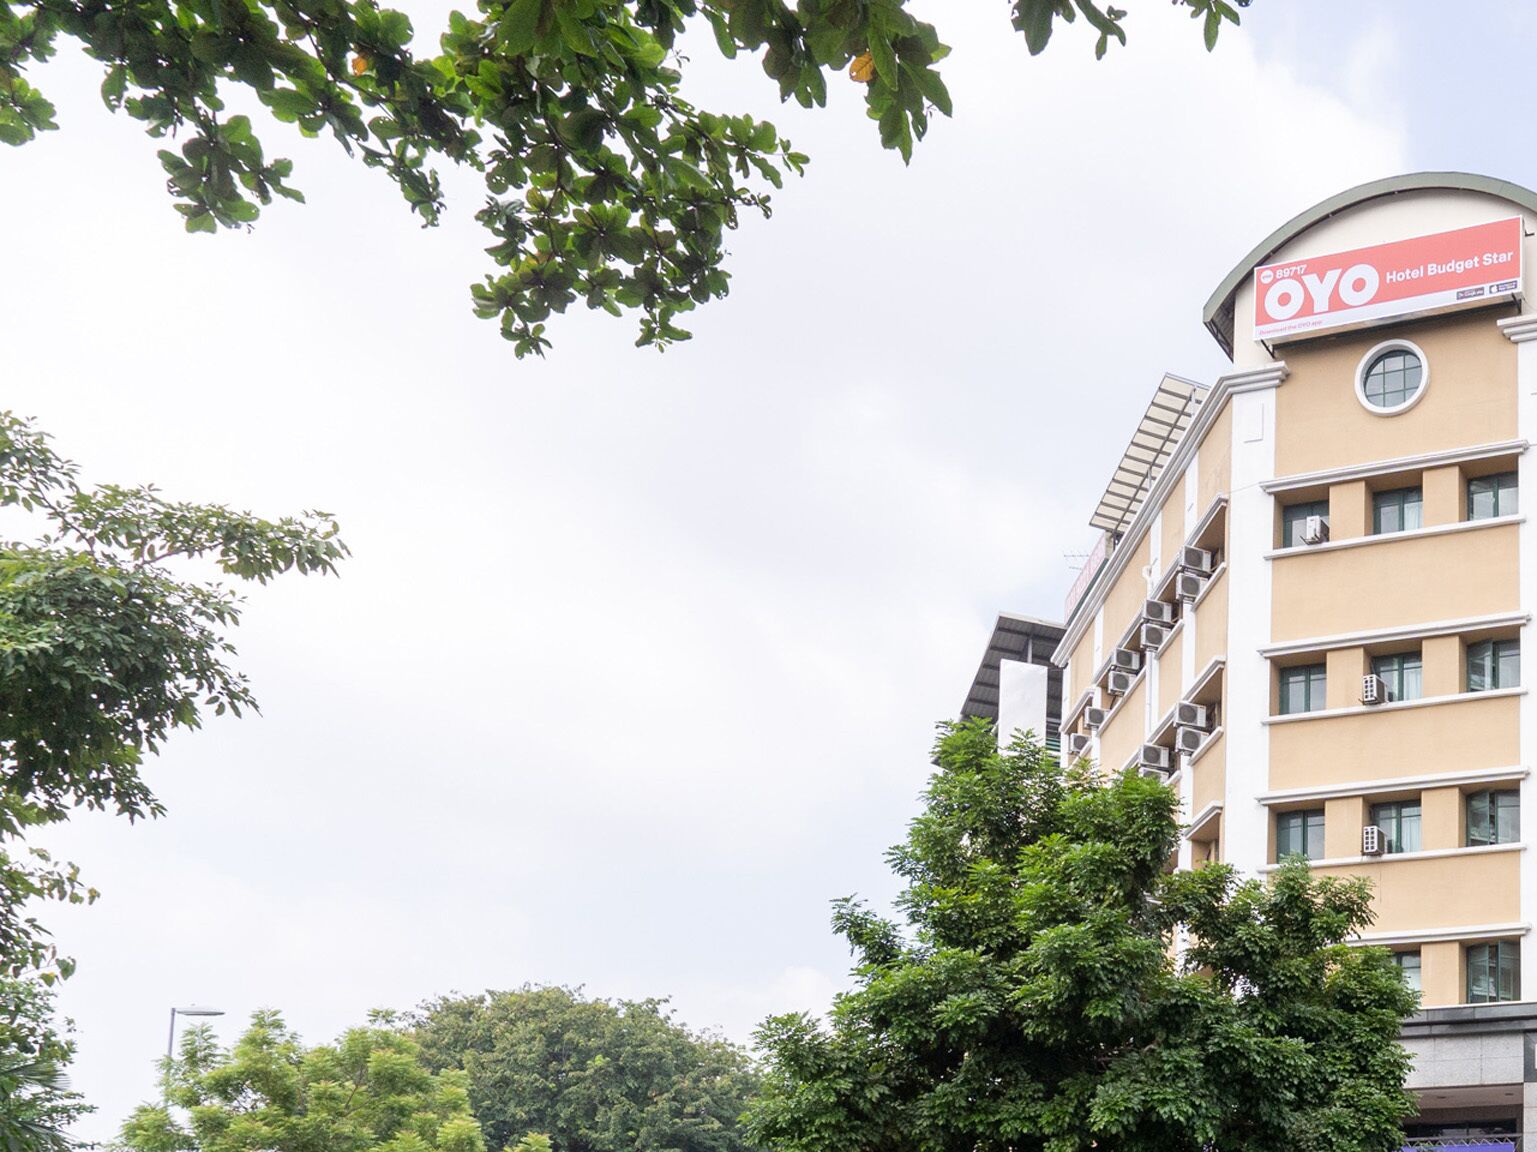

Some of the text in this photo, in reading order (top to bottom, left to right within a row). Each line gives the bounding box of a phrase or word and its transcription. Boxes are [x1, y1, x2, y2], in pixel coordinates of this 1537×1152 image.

[1275, 264, 1307, 279] 89717
[1386, 251, 1514, 284] Hotel Budget Star
[1264, 263, 1380, 320] OYO
